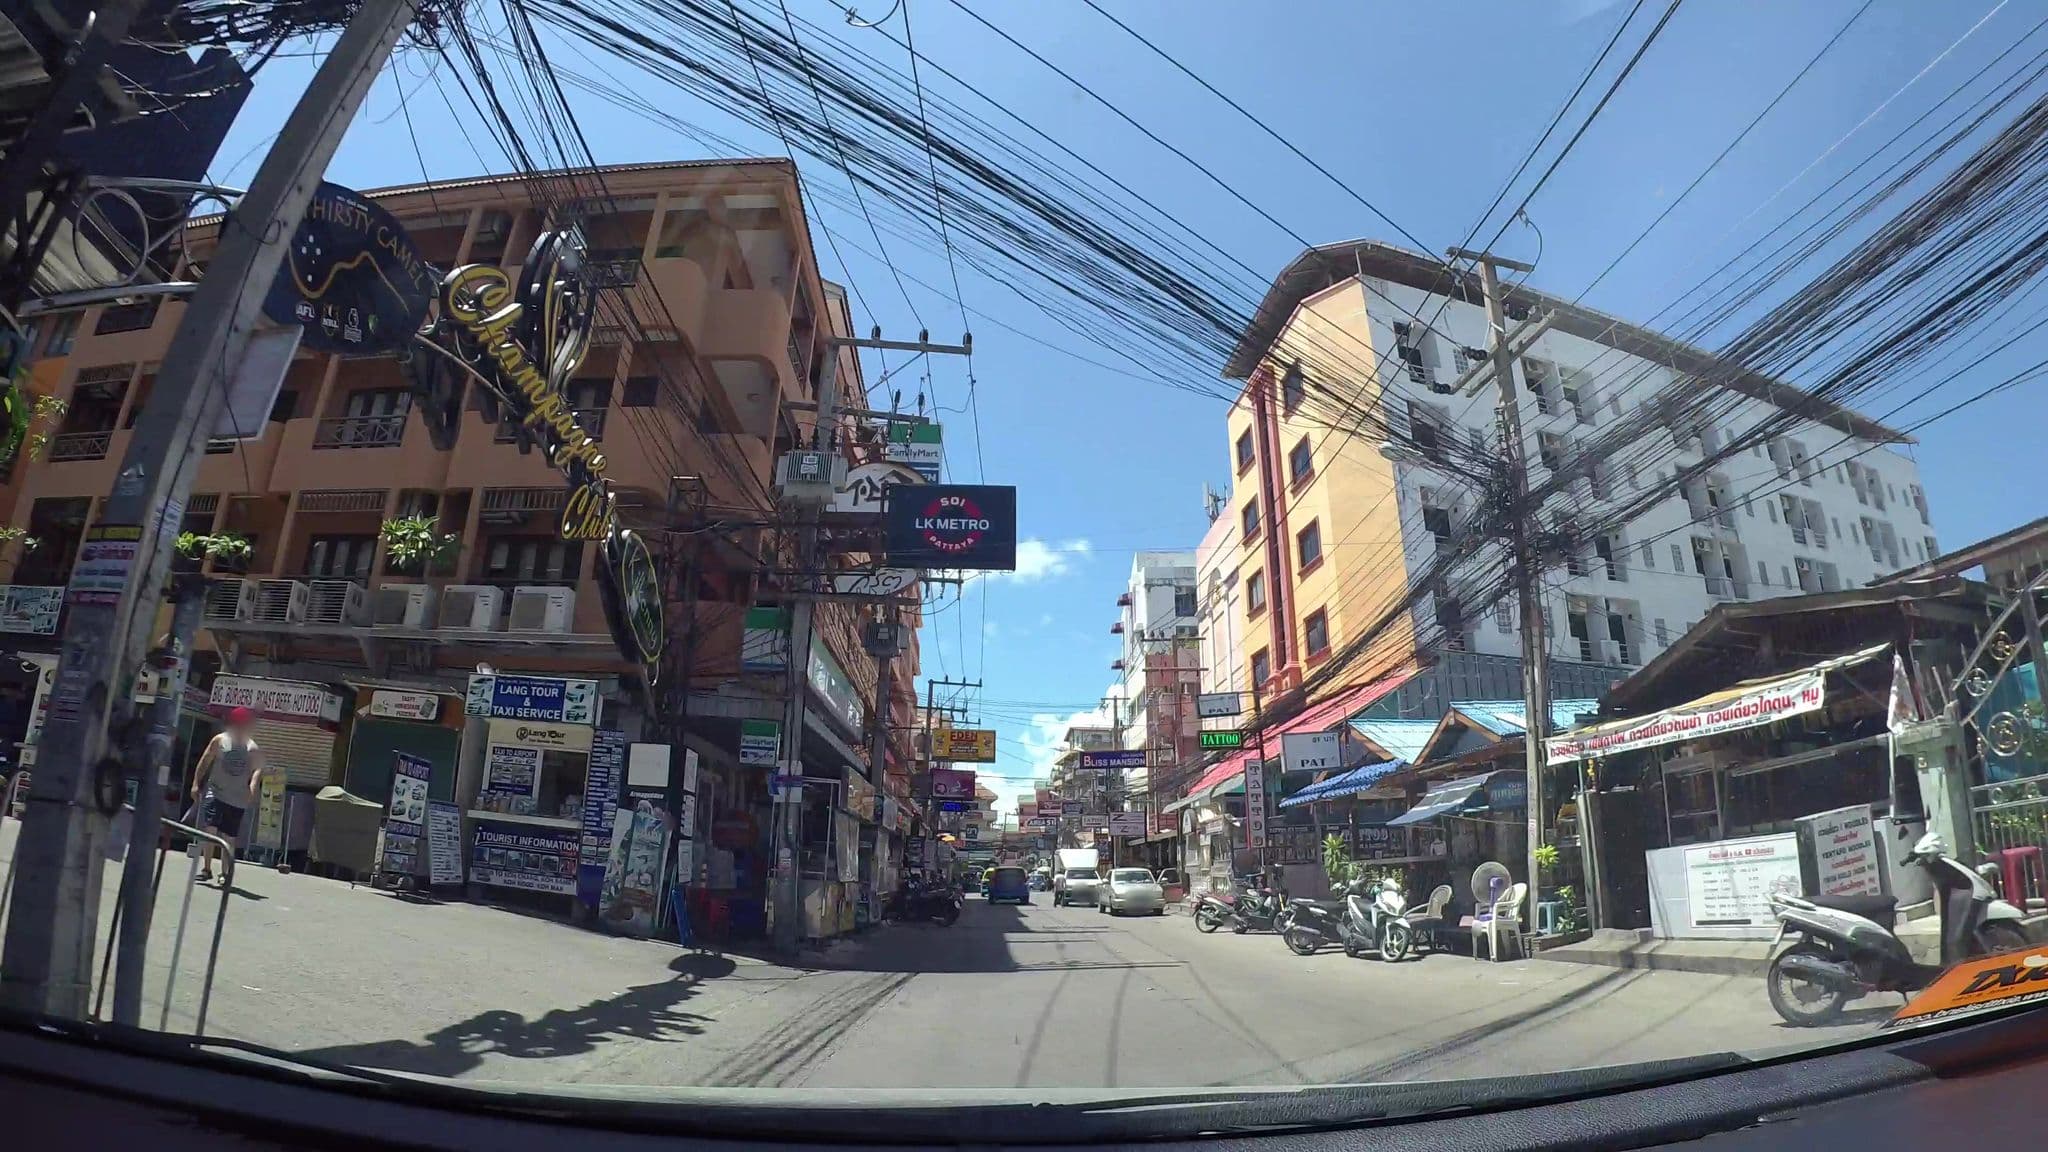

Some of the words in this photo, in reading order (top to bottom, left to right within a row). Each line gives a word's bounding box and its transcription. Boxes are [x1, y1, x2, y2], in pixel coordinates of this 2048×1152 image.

[304, 196, 374, 235] HIRSTY
[378, 226, 424, 291] CAMEL
[296, 303, 316, 318] AFL
[449, 264, 607, 478] Champagne
[889, 447, 939, 459] FamilyMart
[940, 496, 966, 507] SOI
[562, 484, 614, 539] Club
[915, 518, 934, 529] LK
[936, 518, 990, 530] METRO
[929, 535, 974, 550] PATTAYA
[225, 686, 254, 706] BURGERS
[499, 684, 528, 696] LANG
[531, 686, 559, 698] TOUR
[1801, 687, 1820, 706] หมู
[523, 697, 531, 706] &
[492, 705, 515, 716] TAXI
[516, 707, 561, 720] SERVICE
[528, 729, 547, 738] Lang
[547, 730, 566, 739] Tour
[1202, 733, 1240, 746] TATTOO
[1083, 755, 1108, 767] BLISS
[1110, 758, 1145, 766] MANSION
[1300, 757, 1327, 768] PAT
[1249, 765, 1263, 847] TATTOO
[482, 831, 518, 844] TOURIST
[519, 836, 580, 852] INFORMATION
